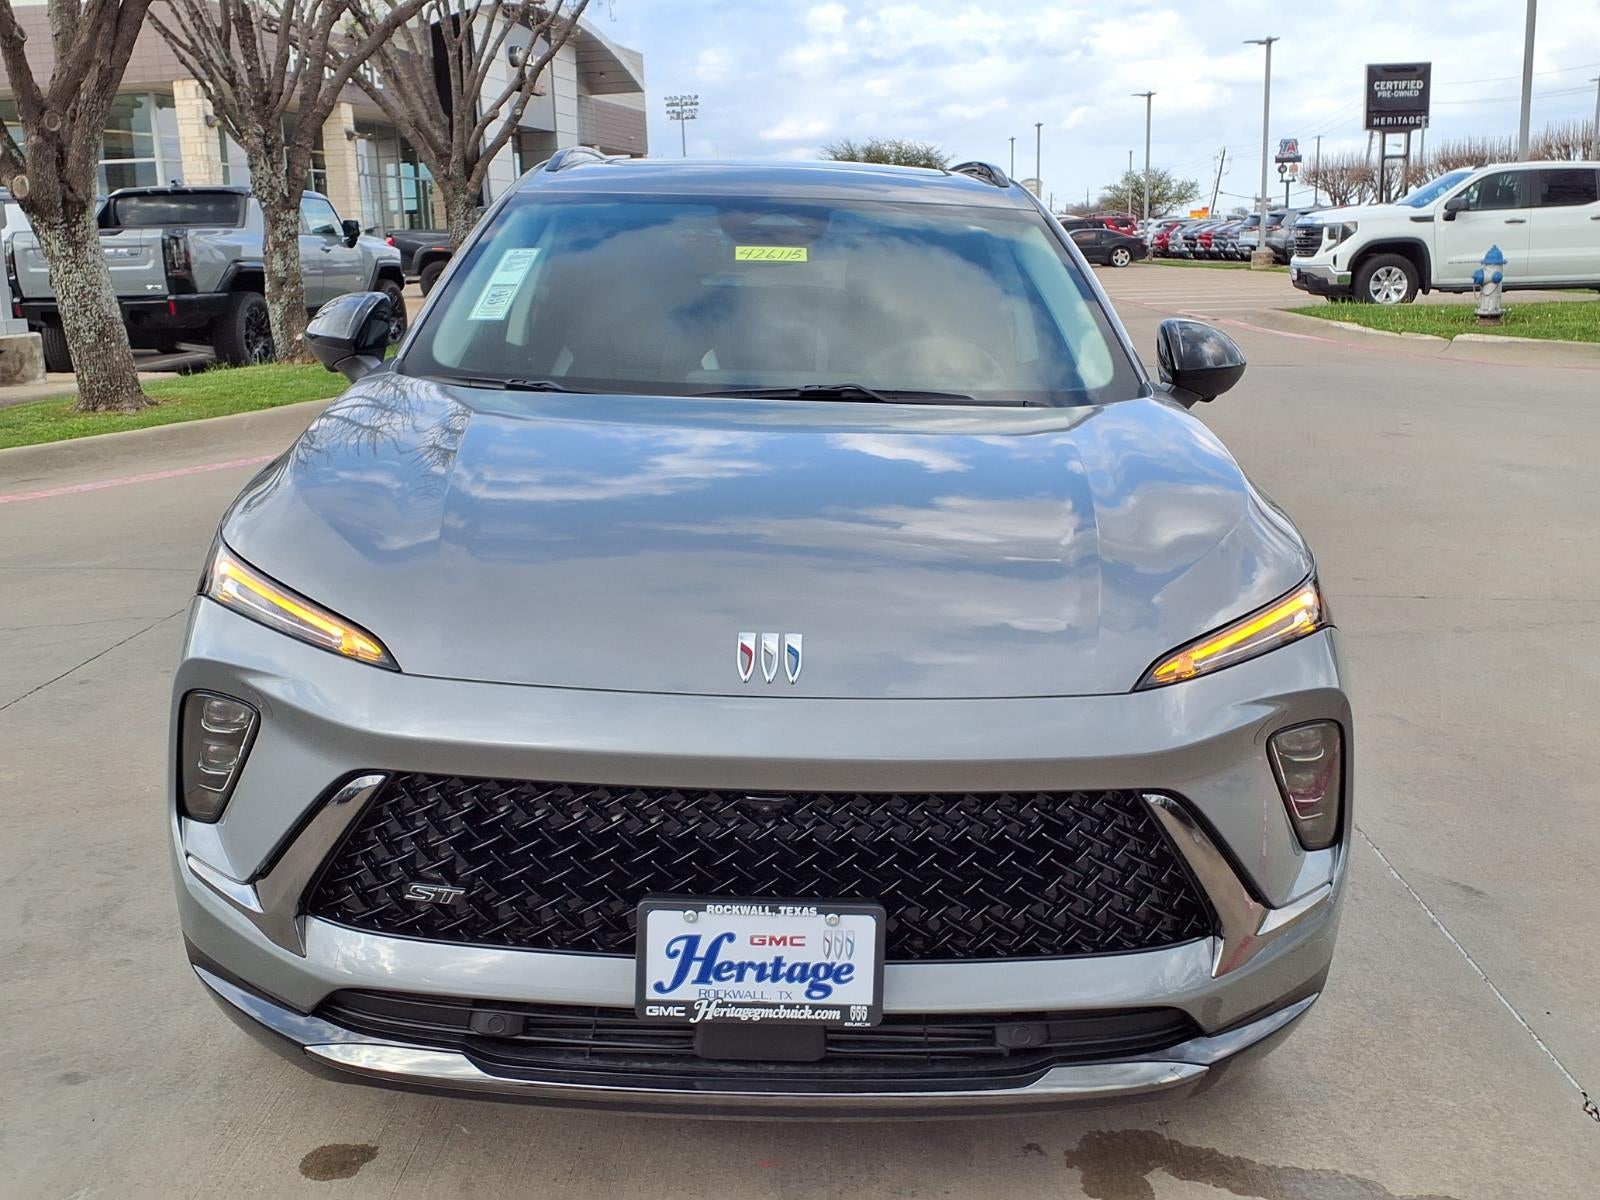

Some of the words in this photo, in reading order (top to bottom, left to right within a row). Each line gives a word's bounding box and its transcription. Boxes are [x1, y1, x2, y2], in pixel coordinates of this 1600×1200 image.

[1373, 80, 1424, 91] CERTIFIED
[1377, 90, 1420, 98] PRE-OWNED
[1373, 115, 1421, 126] HERITAGE
[739, 248, 802, 260] 426115
[403, 882, 466, 904] ST
[706, 904, 777, 917] ROCKWALL,
[779, 906, 818, 917] TEXAS
[749, 934, 807, 947] GMC
[653, 931, 856, 1001] Heritage
[777, 990, 793, 1001] TX
[645, 1005, 686, 1017] GMC
[689, 998, 841, 1023] Heritagegmcbuick.com
